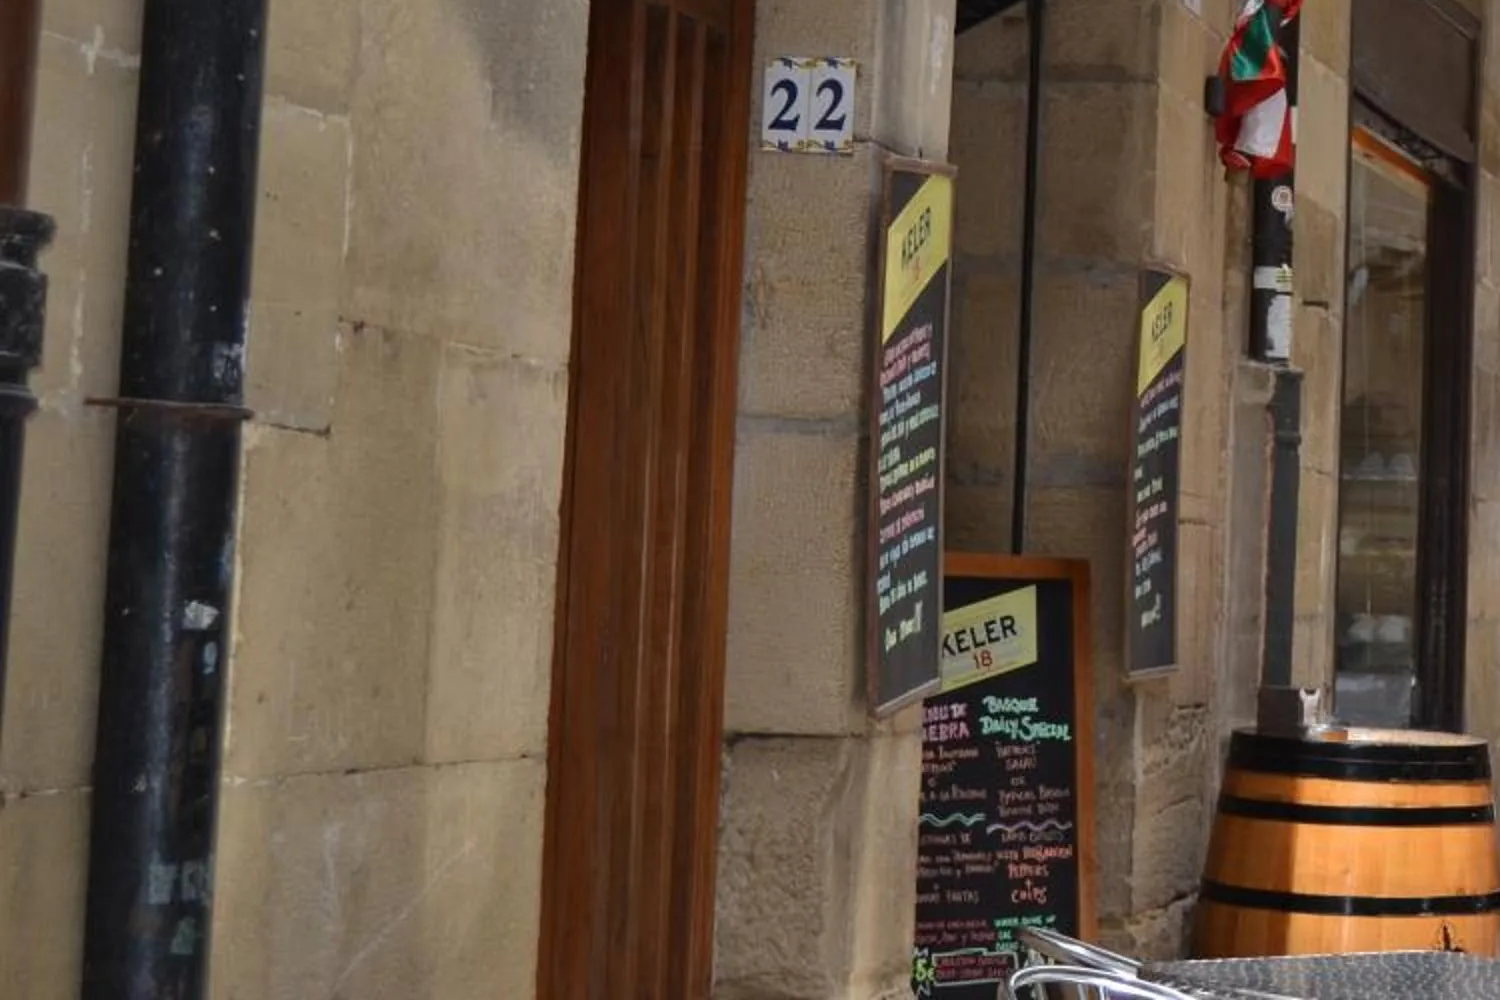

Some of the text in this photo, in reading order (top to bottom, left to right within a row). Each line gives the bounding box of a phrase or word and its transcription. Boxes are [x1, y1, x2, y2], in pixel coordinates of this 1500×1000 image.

[768, 78, 846, 130] 22
[943, 614, 1018, 658] KELER
[973, 650, 994, 671] 18
